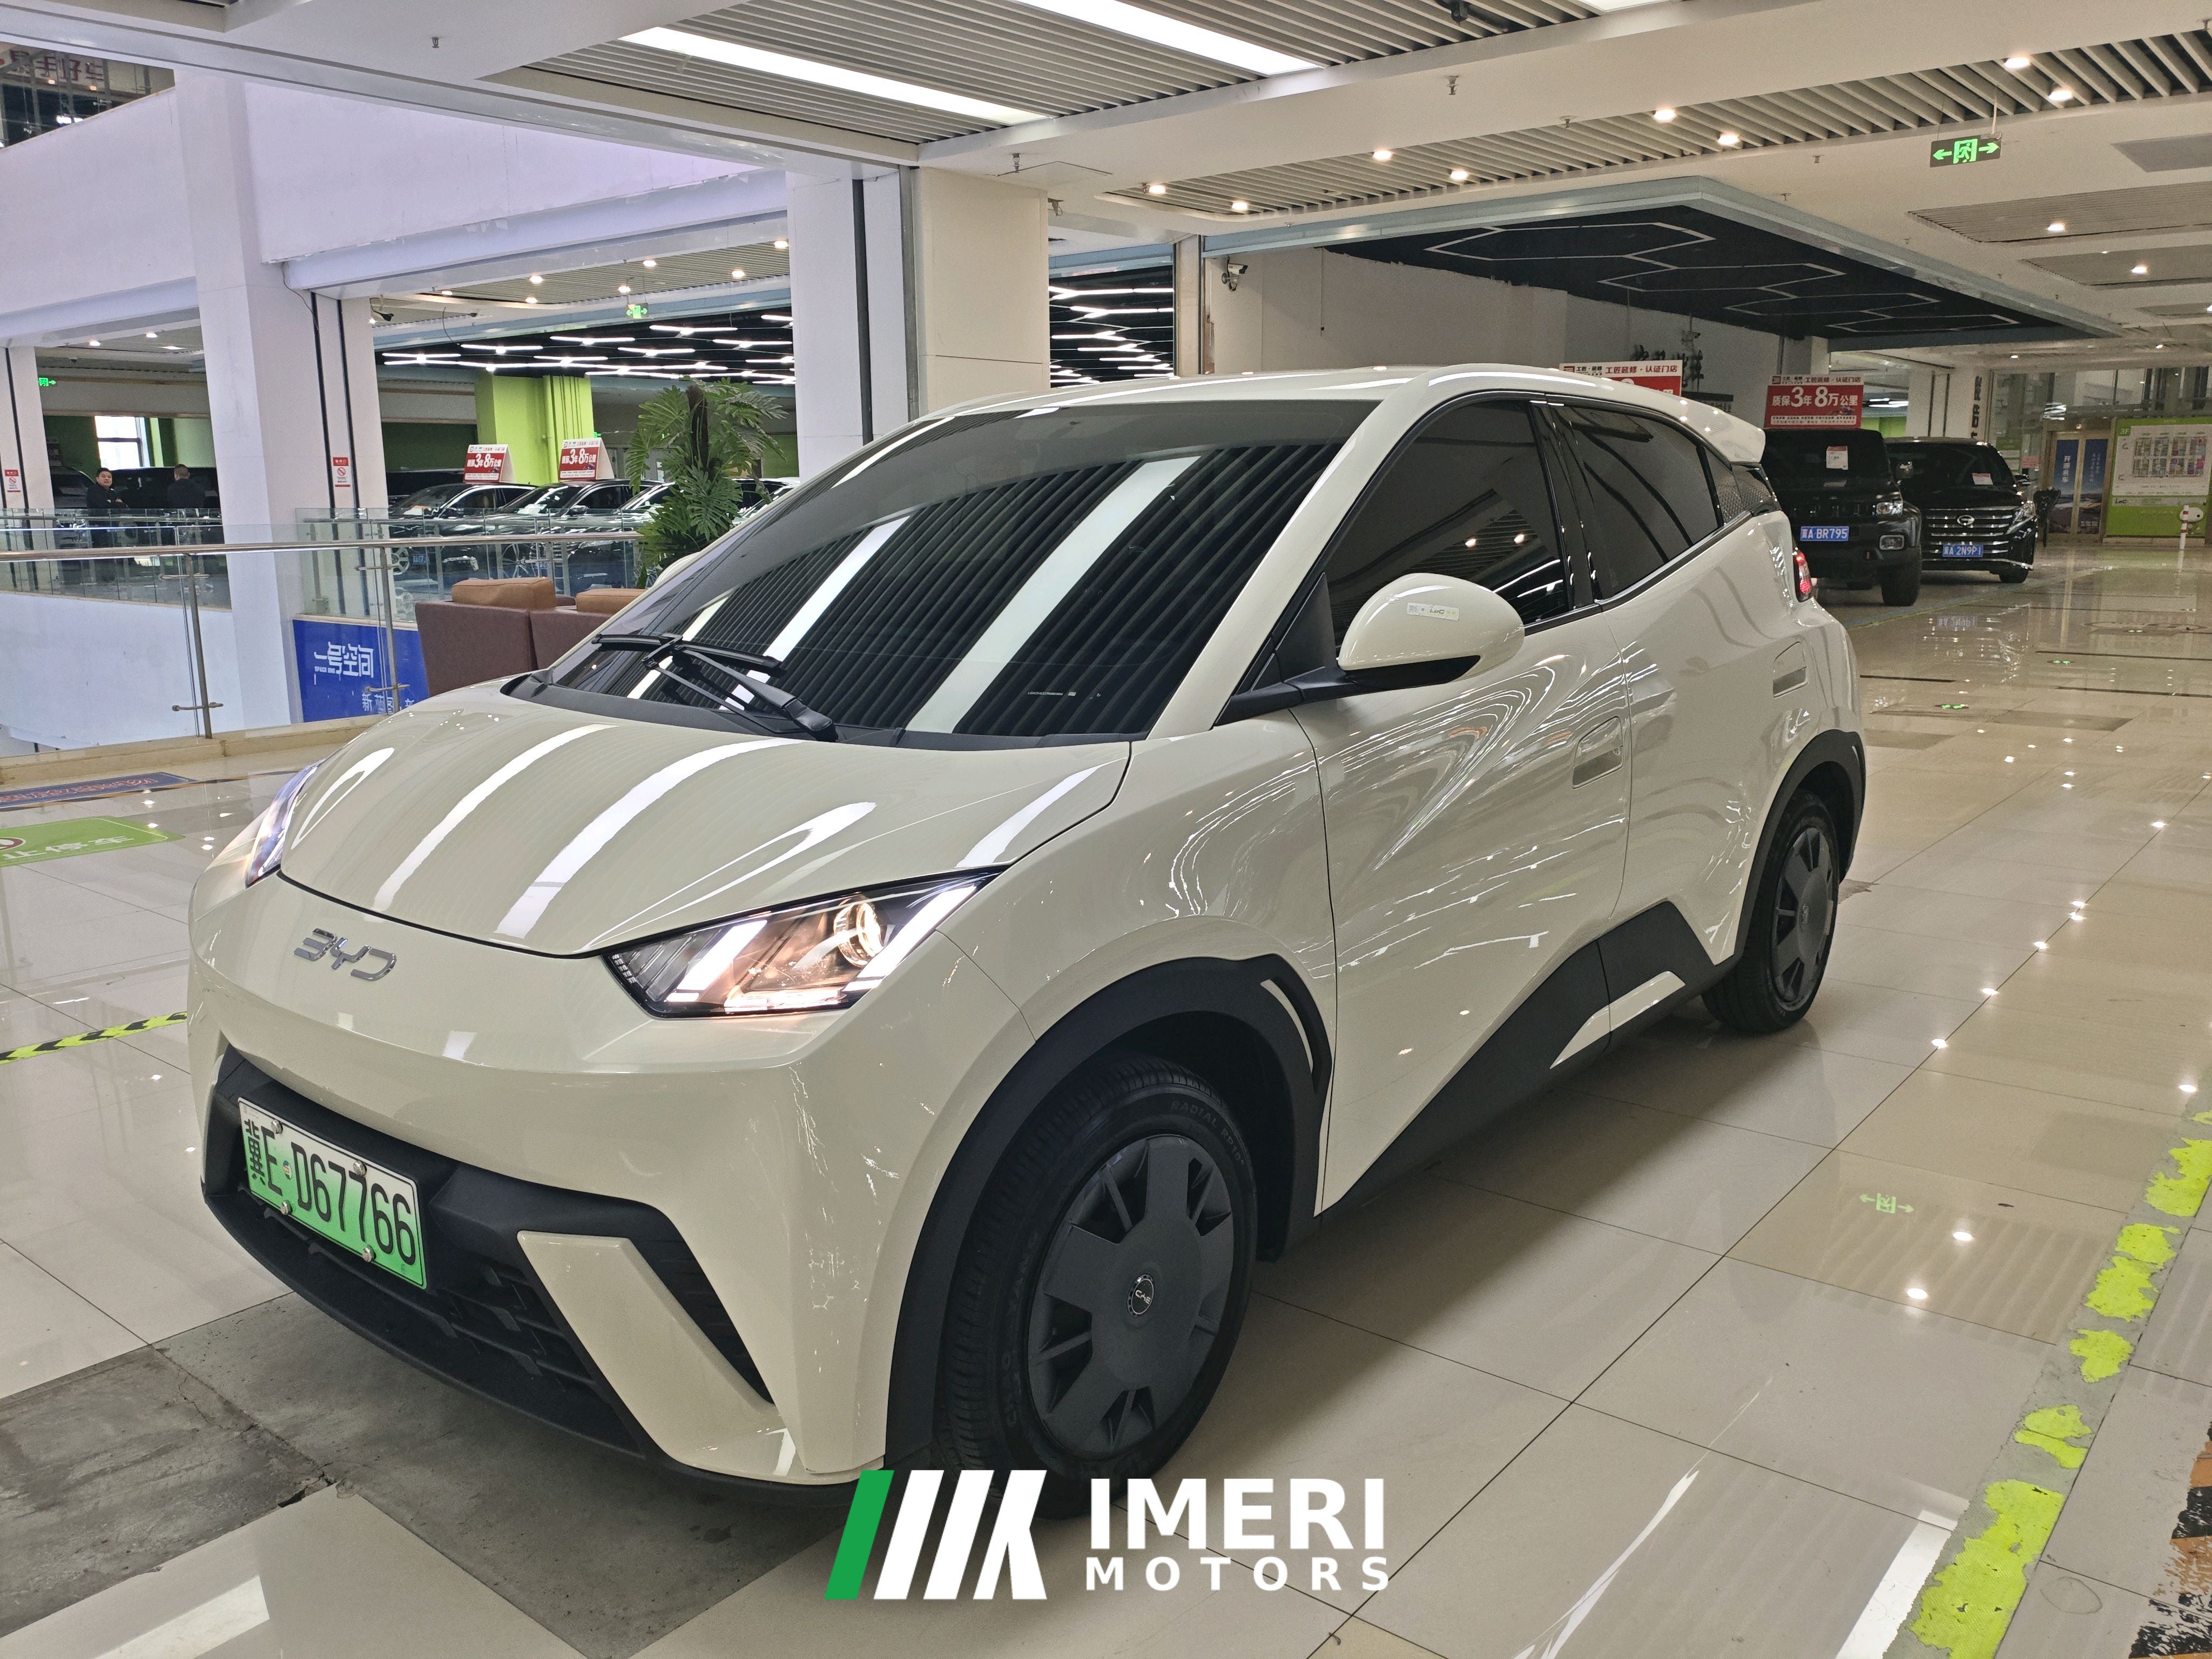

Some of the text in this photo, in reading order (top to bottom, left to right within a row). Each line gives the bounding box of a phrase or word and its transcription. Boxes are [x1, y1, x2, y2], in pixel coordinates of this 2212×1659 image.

[314, 641, 374, 678] 一号空间
[294, 928, 397, 981] BYD
[1171, 1101, 1217, 1128] RADIAL
